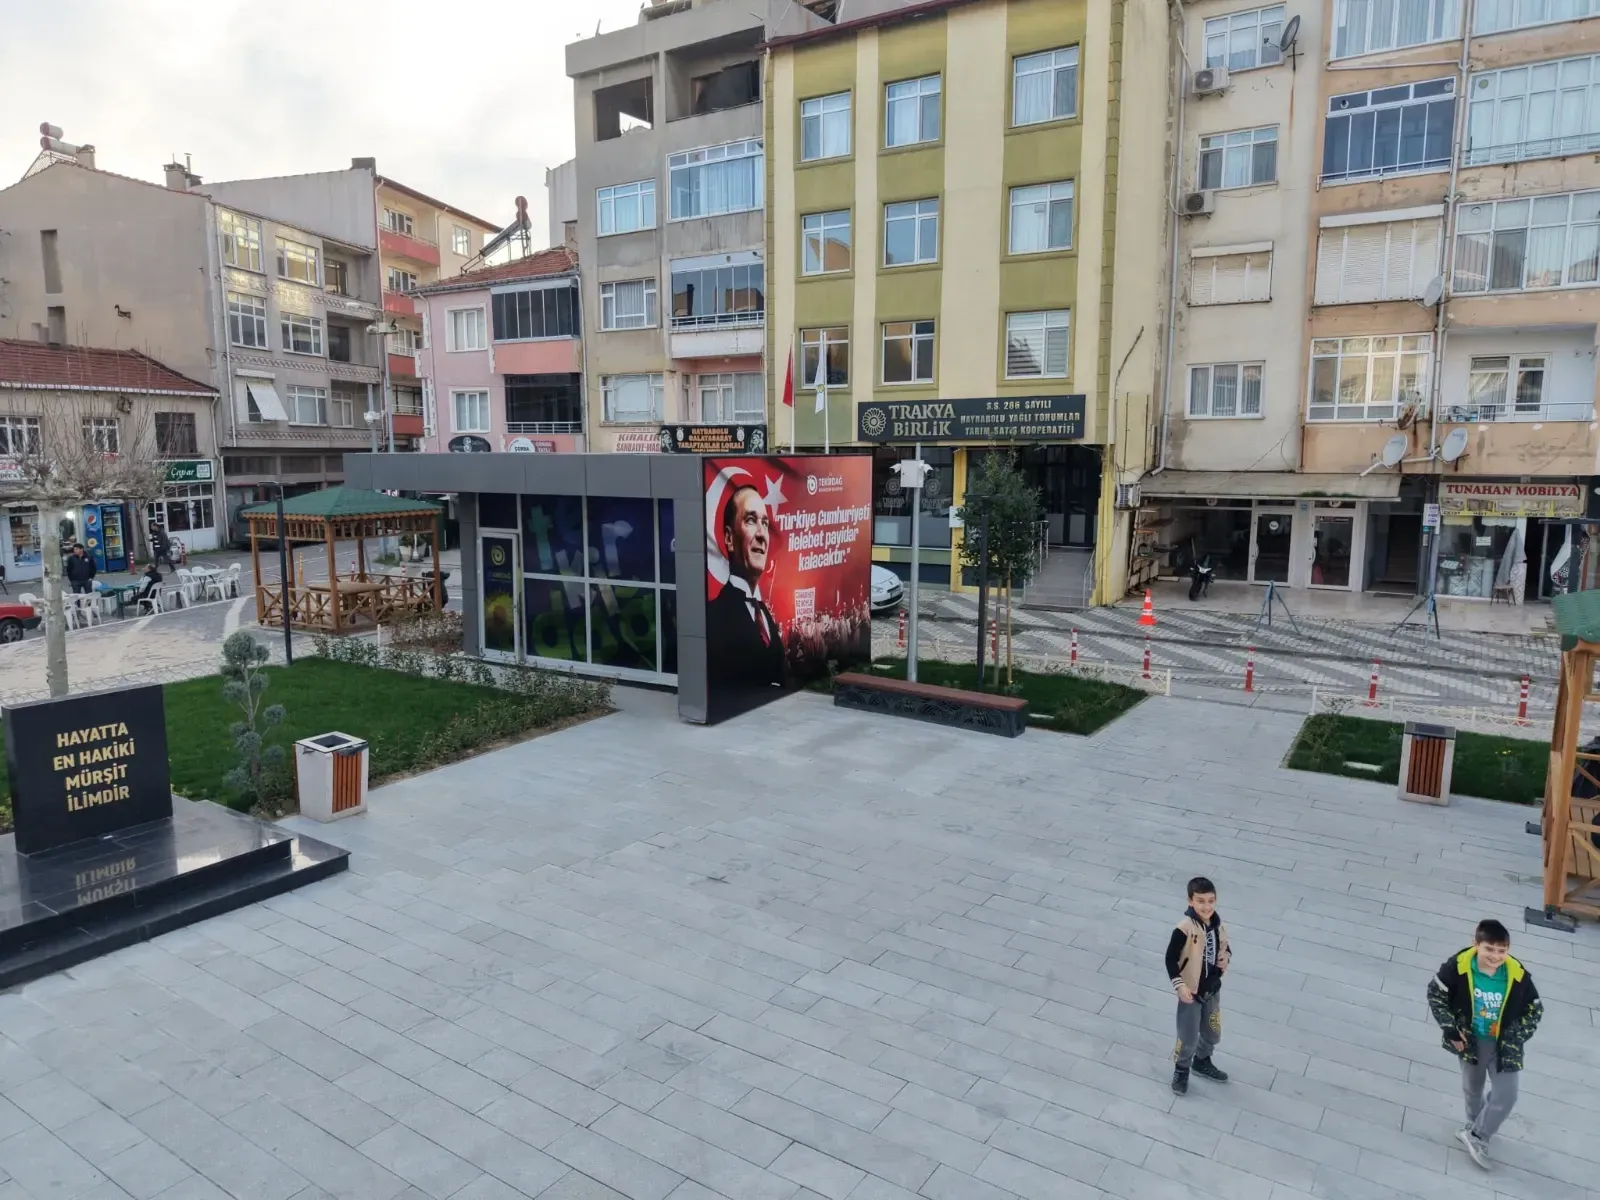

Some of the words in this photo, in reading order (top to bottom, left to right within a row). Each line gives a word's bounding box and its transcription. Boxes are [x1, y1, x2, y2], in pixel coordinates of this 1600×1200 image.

[889, 403, 957, 420] TRAKYA
[960, 413, 1006, 424] HAYRABOLU
[893, 420, 952, 436] BİRLİK
[1021, 423, 1075, 435] KOOPERATİFİ
[1446, 484, 1513, 495] TUNAHAN
[1515, 485, 1578, 496] MOBİLYA
[818, 503, 870, 526] Cumhuriyeti
[788, 530, 824, 552] ilelebet
[825, 525, 859, 550] payidar
[56, 722, 129, 748] HAYATTA
[53, 753, 75, 771] EN
[79, 738, 136, 766] HAKİKİ
[65, 763, 128, 791] MÜRŞİT
[67, 784, 130, 812] İLİMDİR
